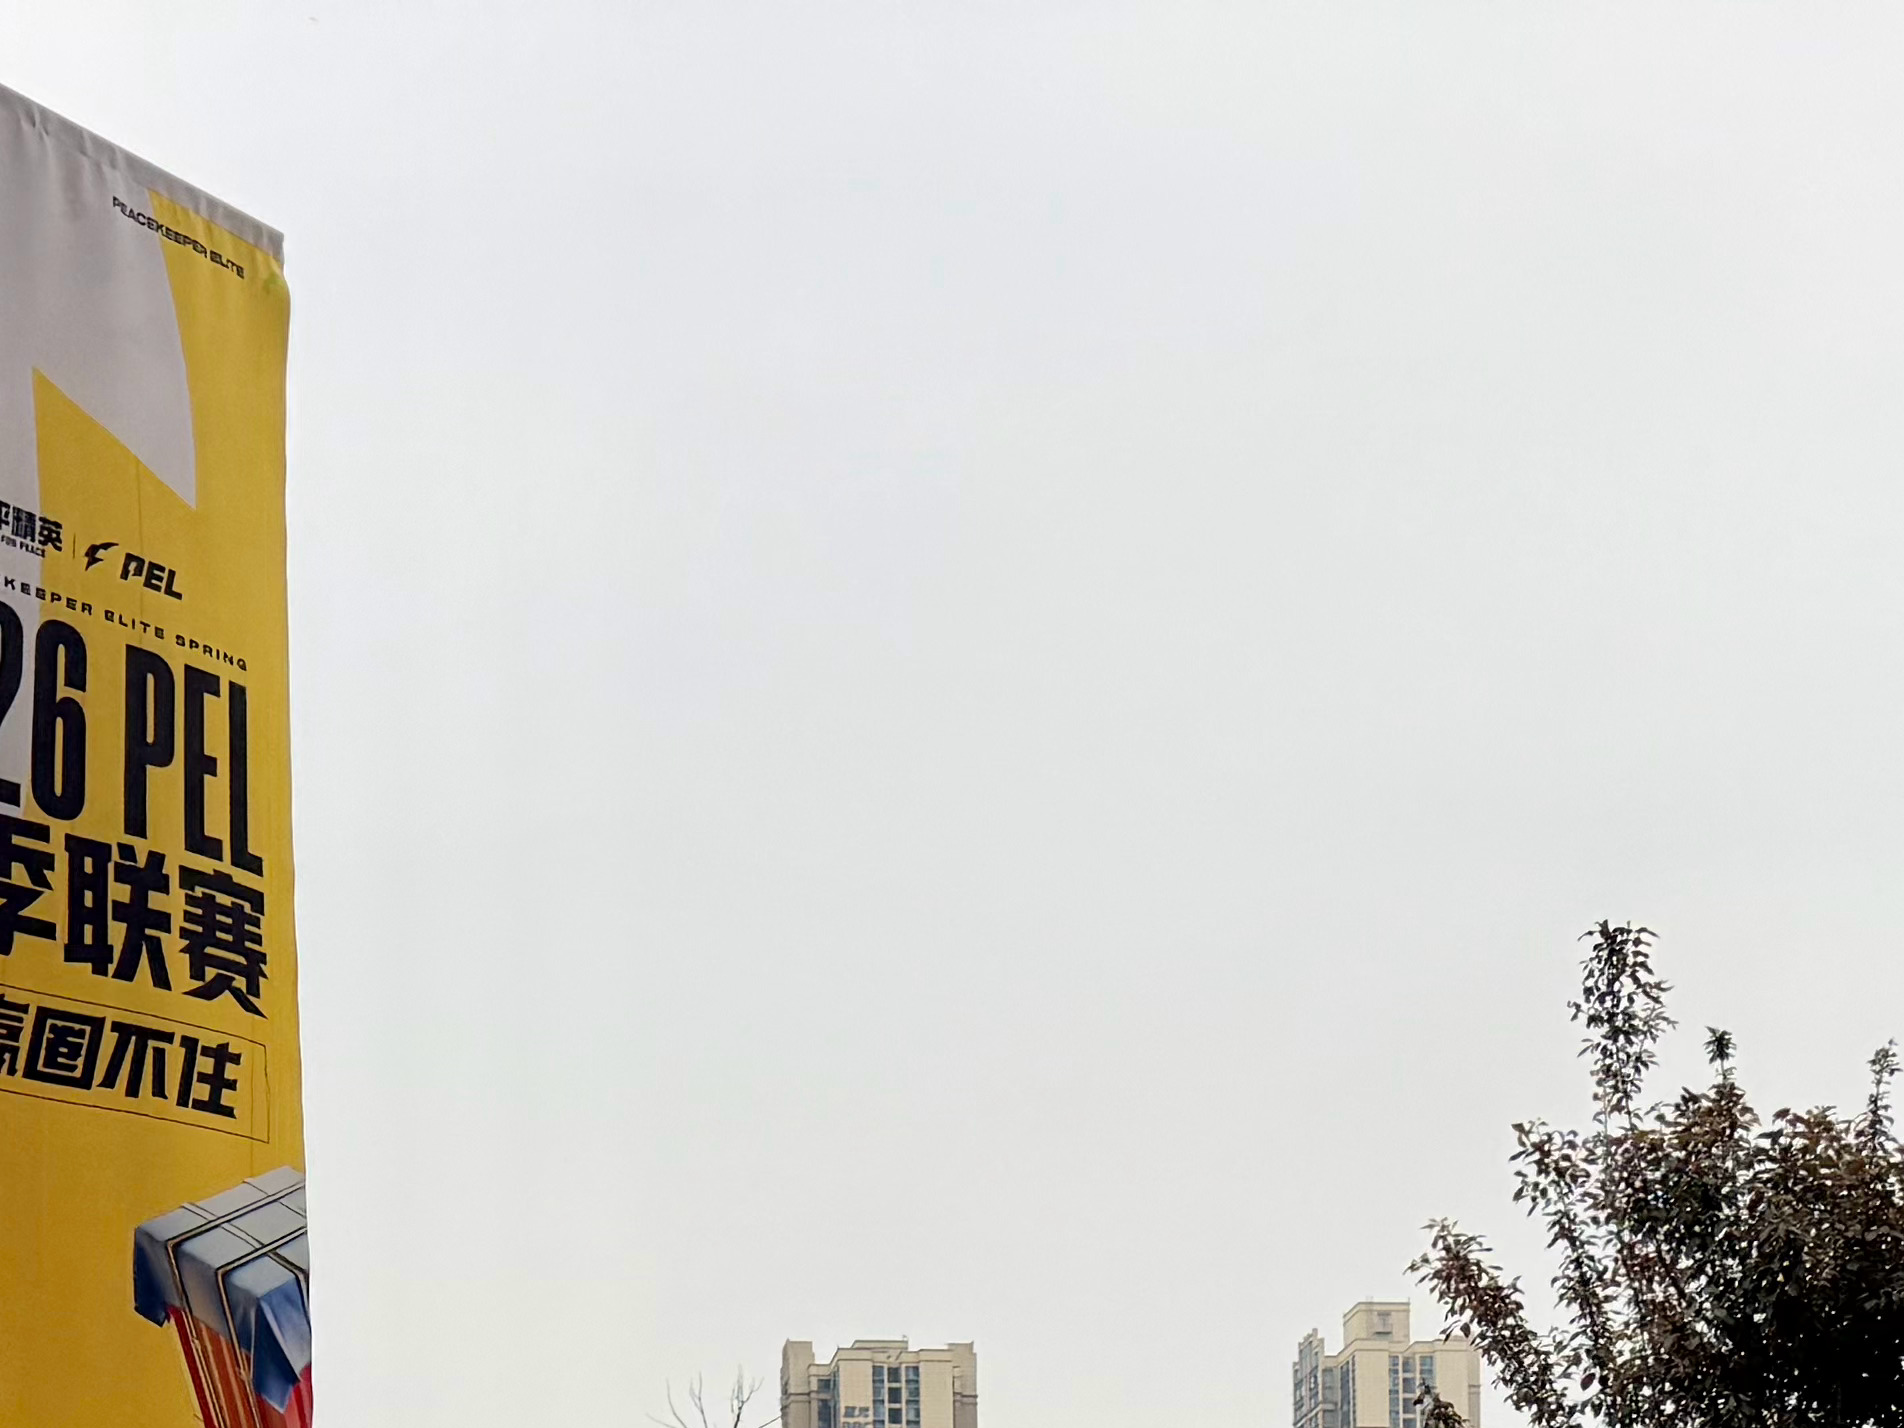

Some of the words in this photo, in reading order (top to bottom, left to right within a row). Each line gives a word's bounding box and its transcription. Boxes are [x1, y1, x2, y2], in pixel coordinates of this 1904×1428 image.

[112, 195, 208, 259] PEACEKEEPER
[209, 246, 245, 280] ELITE
[120, 551, 183, 600] PEL
[103, 608, 165, 640] ELITE
[175, 633, 248, 672] SPRING
[123, 643, 264, 878] PEL
